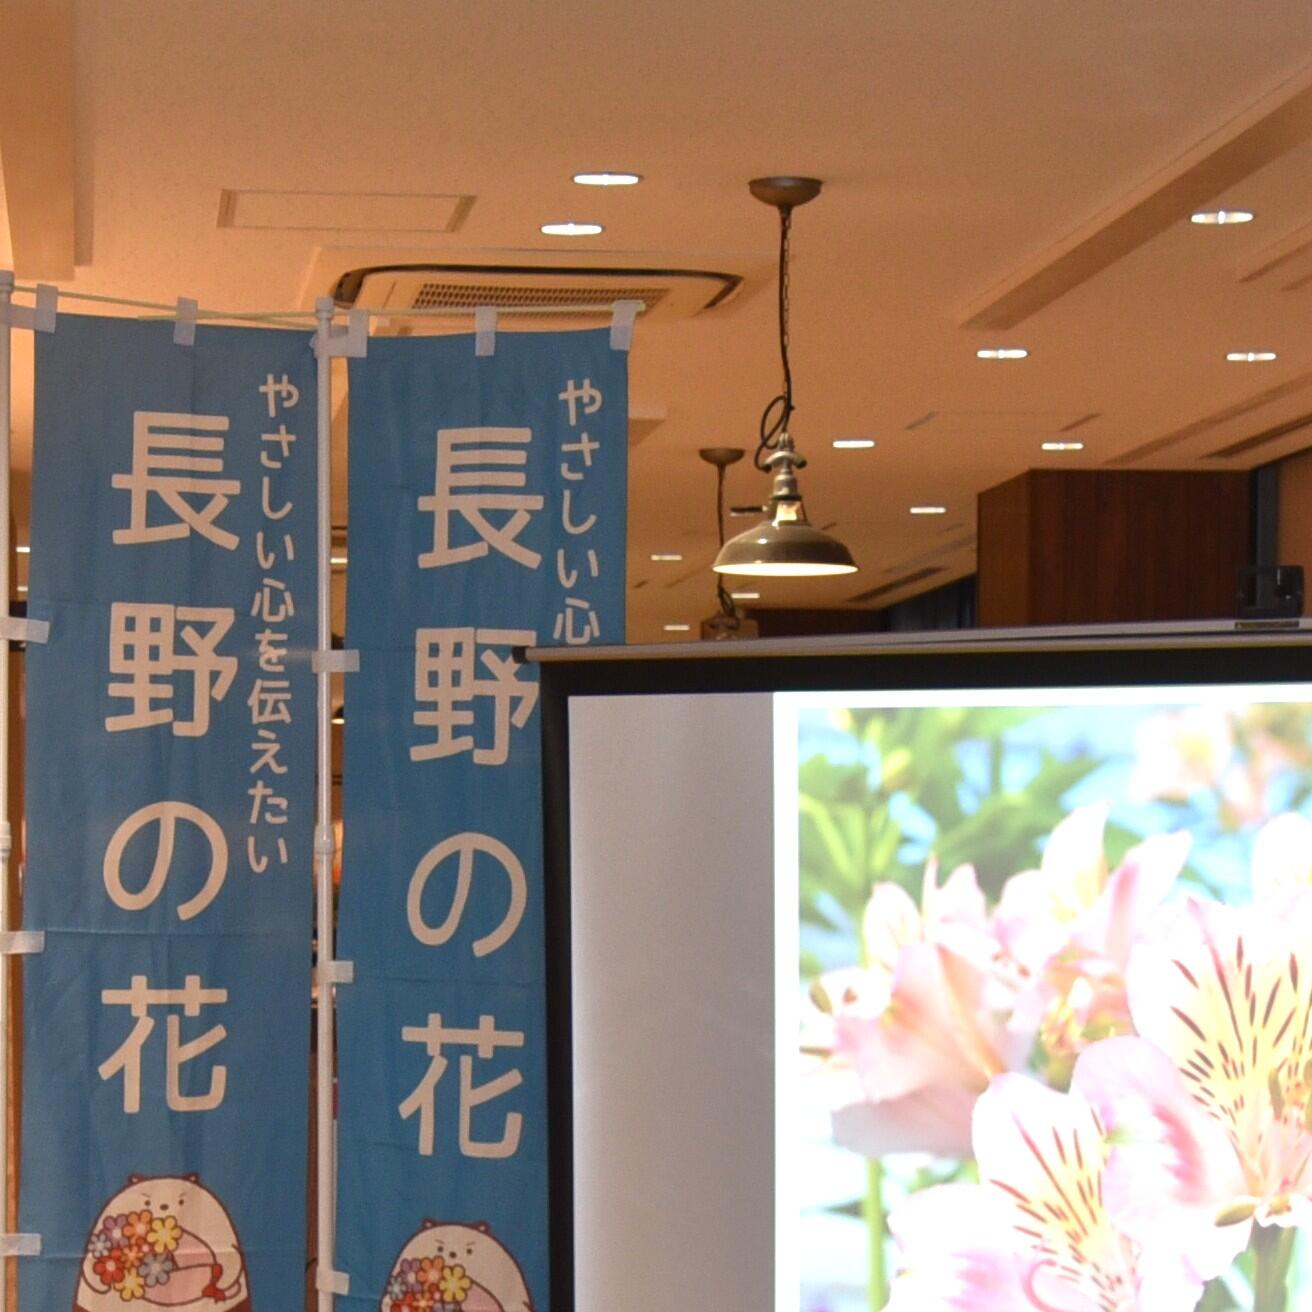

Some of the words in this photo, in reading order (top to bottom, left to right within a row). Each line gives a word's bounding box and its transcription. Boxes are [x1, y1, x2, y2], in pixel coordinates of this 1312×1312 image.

[98, 411, 241, 1113] 長野の花
[247, 373, 299, 873] やさしい心を伝えたい
[398, 427, 544, 1159] 長野の花
[554, 378, 602, 644] やさしい心
